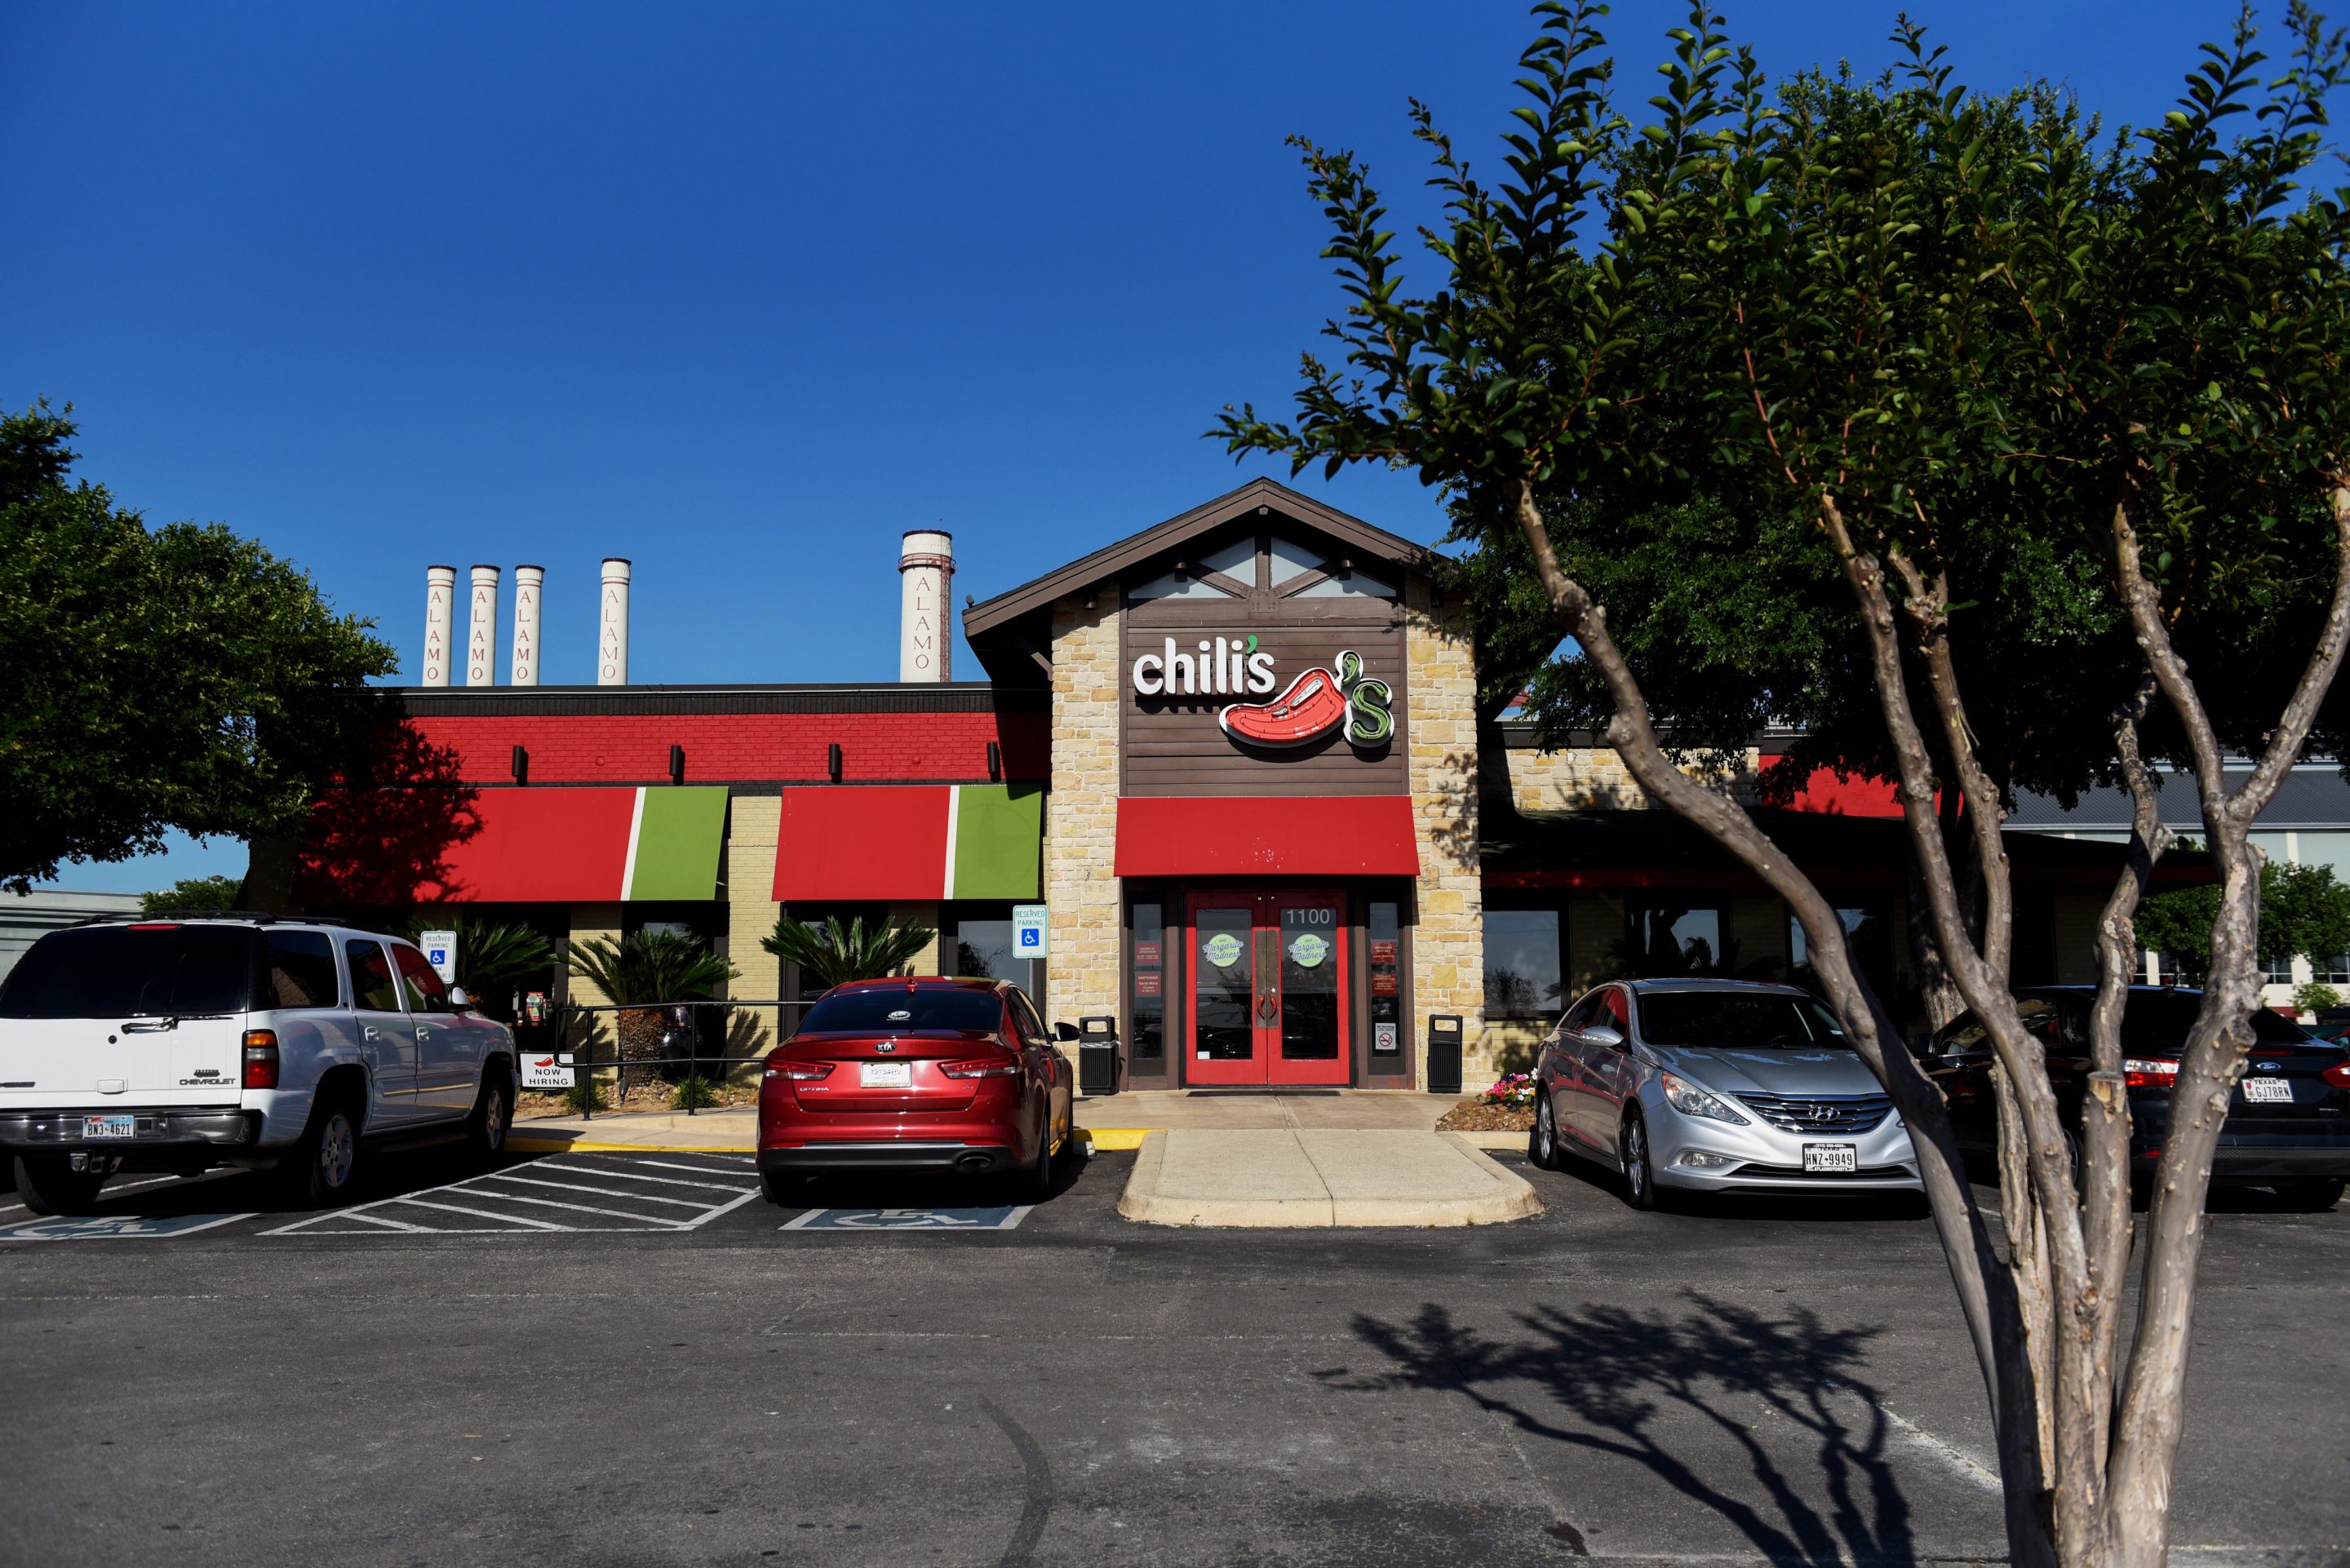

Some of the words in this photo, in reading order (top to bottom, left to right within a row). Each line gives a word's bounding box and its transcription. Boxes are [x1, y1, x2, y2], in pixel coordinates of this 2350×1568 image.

[914, 576, 931, 670] ALAMO
[427, 590, 442, 680] ALAMO
[471, 590, 487, 680] ALAMO
[517, 590, 531, 680] ALAMO
[602, 588, 619, 679] ALAMO
[1133, 634, 1275, 694] chili's
[1287, 909, 1330, 924] 1100
[1203, 940, 1244, 955] Margarita
[1288, 940, 1329, 955] Margarita
[1206, 950, 1241, 962] Madness
[1292, 950, 1327, 962] Madness
[877, 1043, 893, 1052] KIA
[179, 1078, 237, 1086] CHEVROLET
[529, 1078, 569, 1086] HIRING
[2255, 1086, 2291, 1098] GJ78RN
